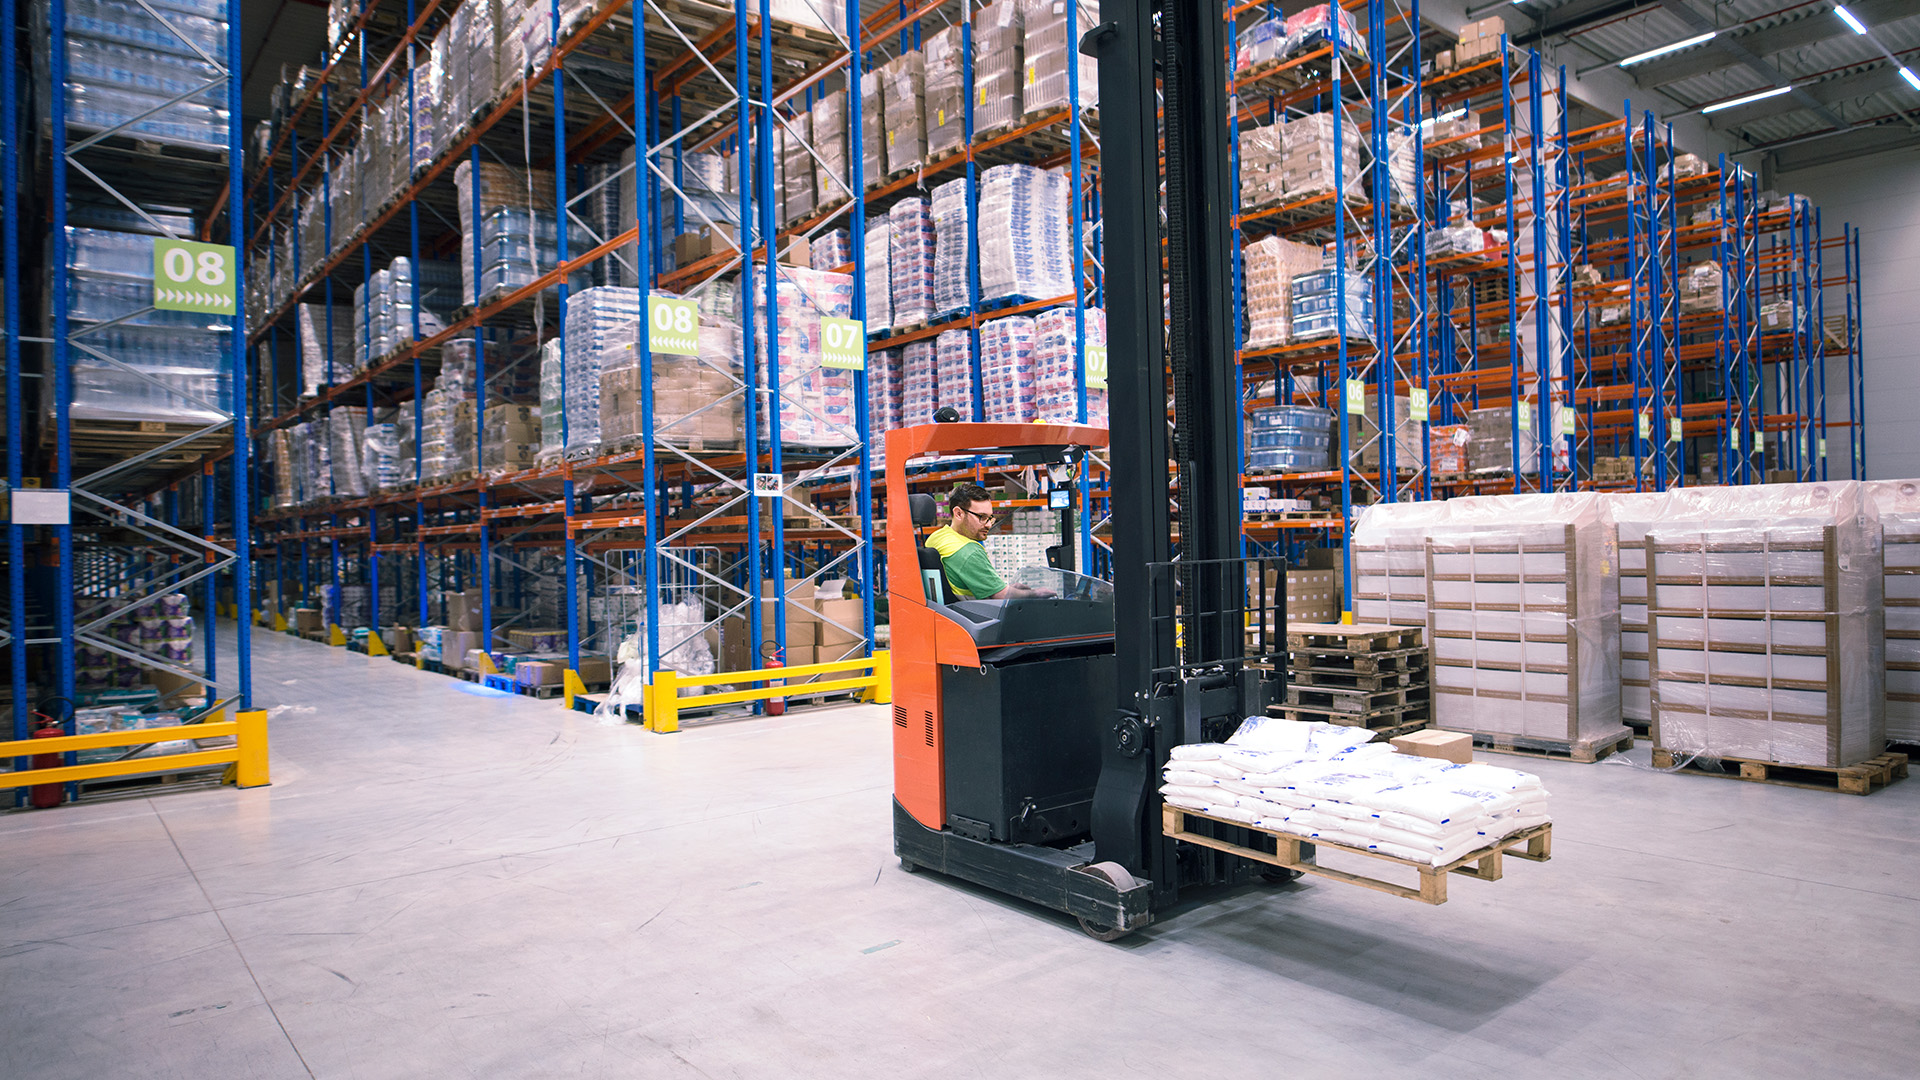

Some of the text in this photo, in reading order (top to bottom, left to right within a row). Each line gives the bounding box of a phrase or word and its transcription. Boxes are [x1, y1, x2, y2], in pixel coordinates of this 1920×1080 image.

[164, 248, 226, 286] 08
[654, 303, 692, 333] 08
[826, 322, 858, 350] 07
[1348, 383, 1363, 401] 06
[1412, 391, 1426, 408] 05
[1519, 404, 1529, 419] 05
[1563, 410, 1573, 424] 04
[1673, 420, 1681, 432] 03
